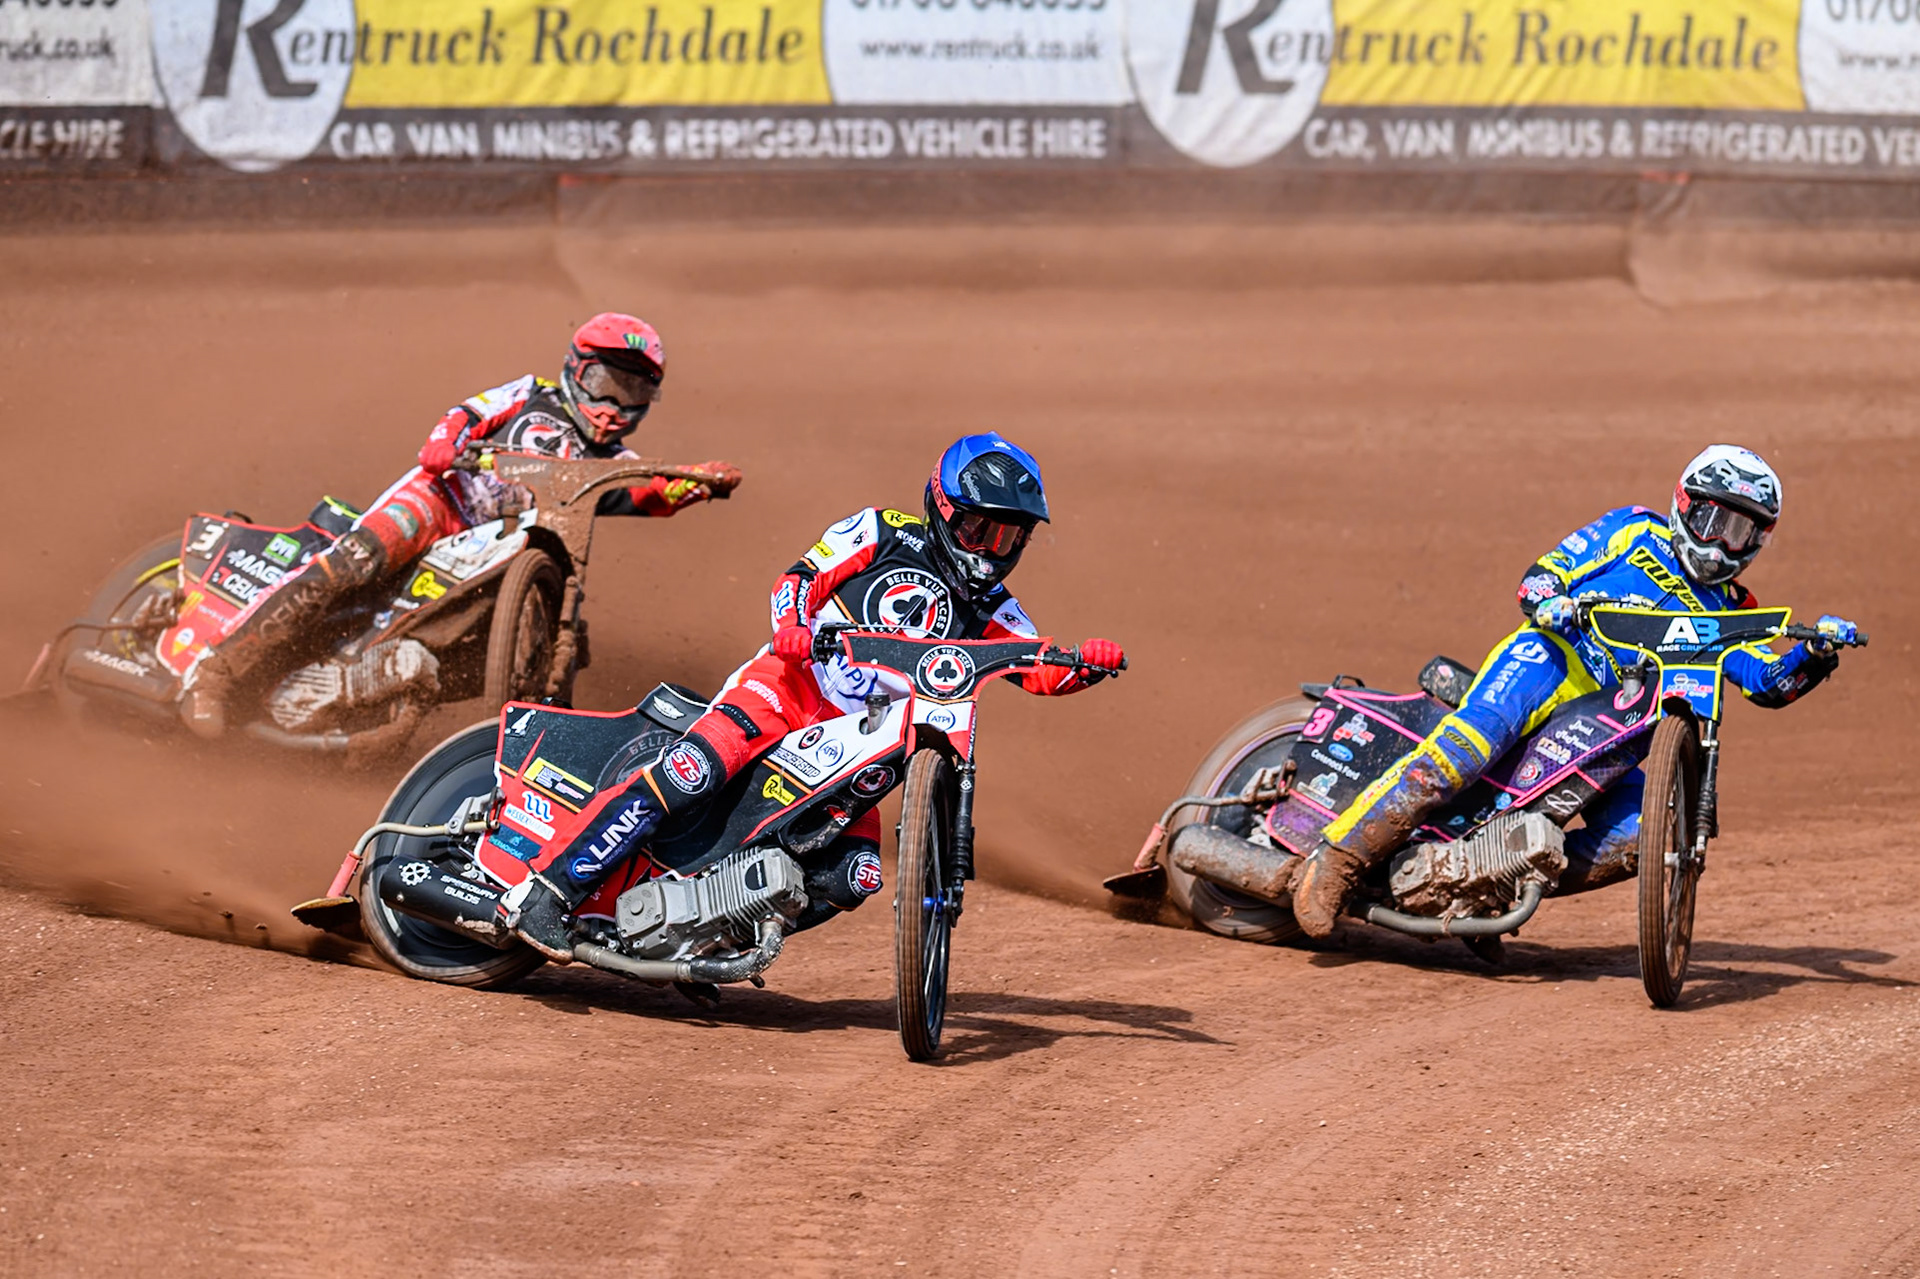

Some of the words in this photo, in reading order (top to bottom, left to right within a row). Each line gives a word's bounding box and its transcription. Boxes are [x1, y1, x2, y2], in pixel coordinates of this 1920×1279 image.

[200, 0, 506, 98] Rentruck
[531, 4, 803, 66] Rochdale
[1176, 0, 1488, 95] Rentruck
[1510, 9, 1781, 71] Rochdale
[53, 118, 123, 159] HIRE
[493, 120, 622, 160] MINIBUS
[629, 118, 656, 158] &
[665, 118, 894, 160] REFRIGERATED
[900, 118, 1027, 159] VEHICLE
[1032, 118, 1107, 159] HIRE
[1610, 118, 1634, 158] &
[1641, 119, 1867, 164] REFRIGERATED
[190, 523, 225, 551] 3
[895, 528, 926, 550] ROWE
[885, 572, 921, 587] BELLE
[925, 578, 946, 598] VUE
[935, 600, 948, 630] ACES
[1661, 616, 1721, 645] AB
[921, 650, 939, 668] BELLE
[957, 653, 972, 669] ACES
[930, 715, 951, 724] ATPI
[1303, 706, 1336, 737] 3
[671, 751, 701, 781] STS
[1311, 748, 1344, 772] Cessnock
[1341, 765, 1361, 780] Ford
[588, 799, 651, 860] LINK
[440, 874, 498, 900] SPEEDWAY
[856, 865, 881, 884] STS
[444, 885, 481, 905] BUILDS
